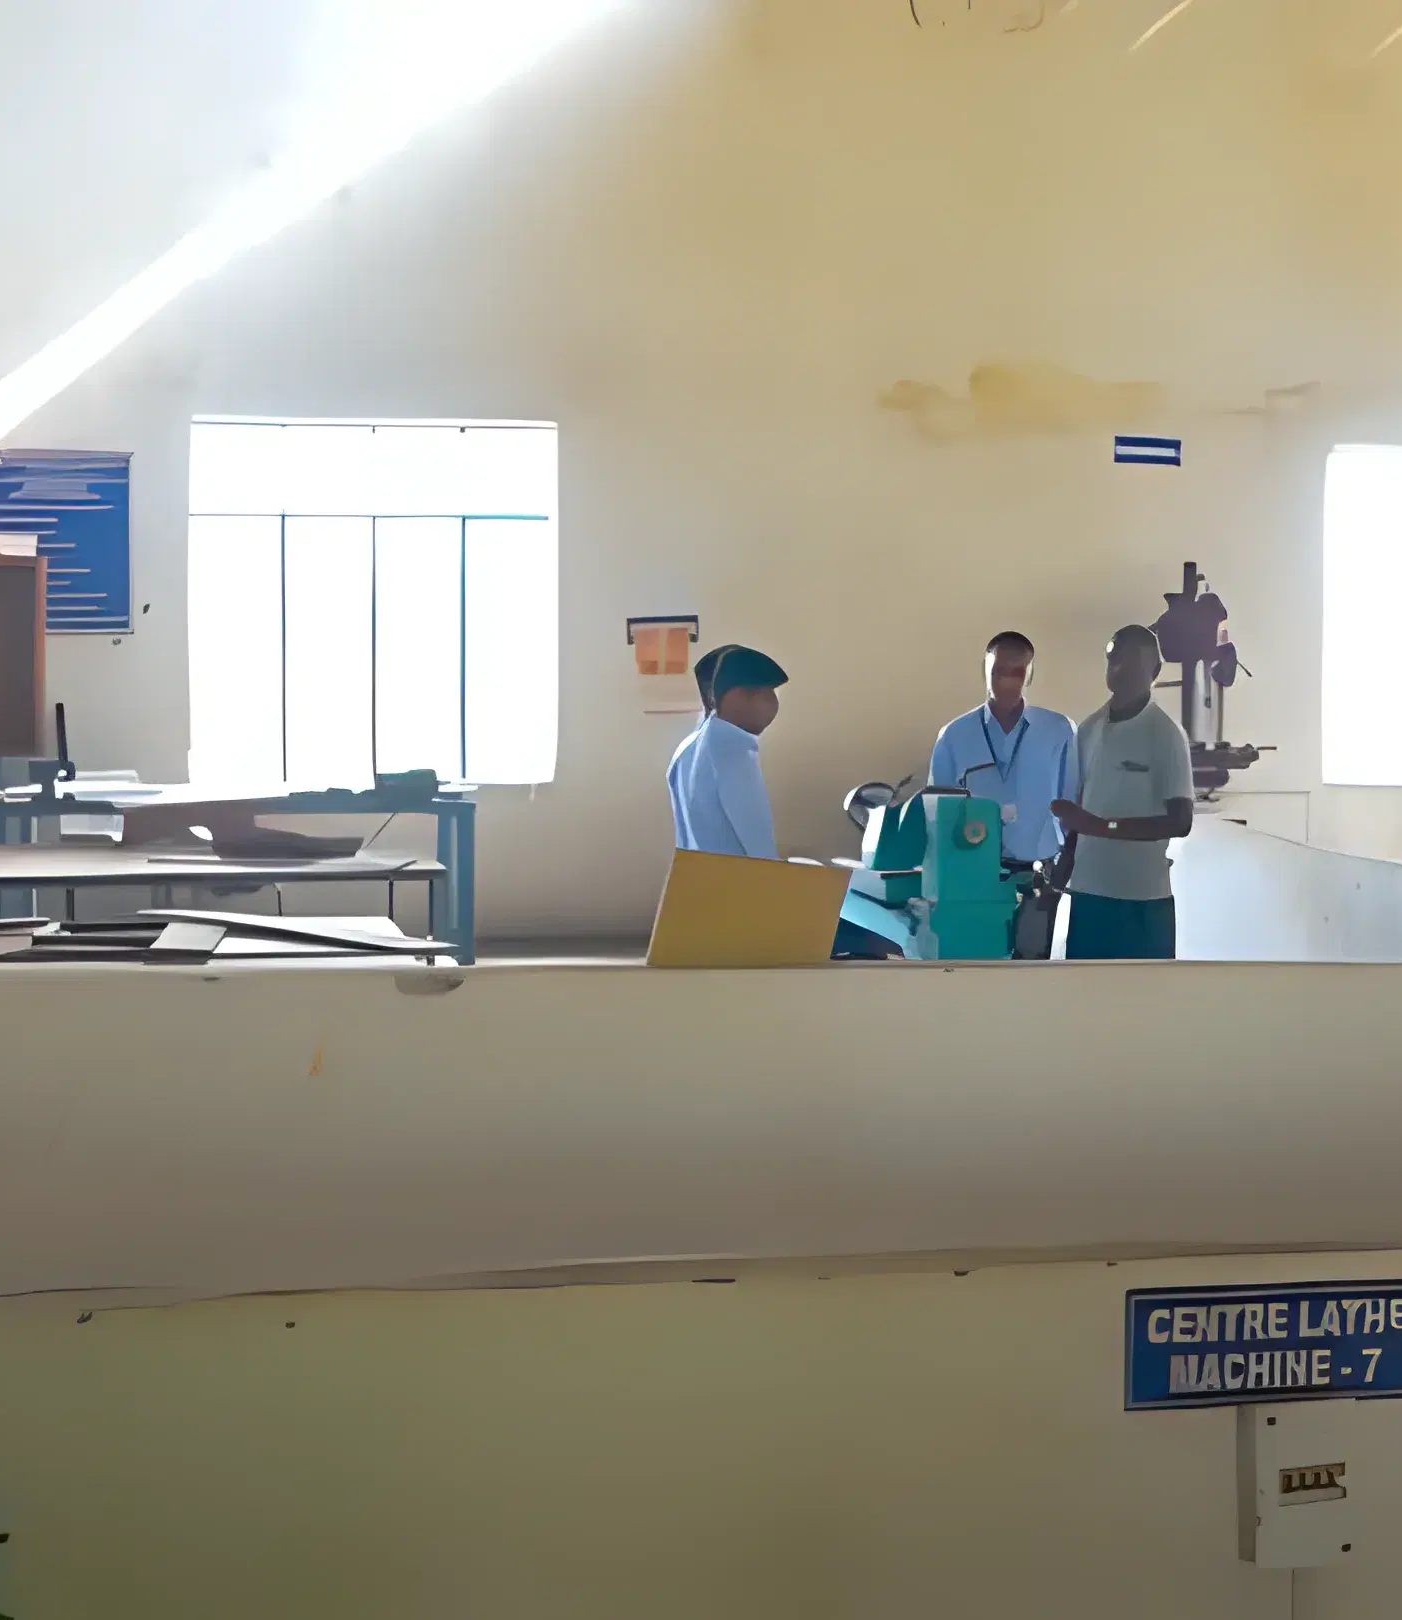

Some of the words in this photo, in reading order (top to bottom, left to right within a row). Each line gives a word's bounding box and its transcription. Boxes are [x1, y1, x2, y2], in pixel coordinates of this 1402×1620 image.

[1148, 1303, 1289, 1343] CENTRE
[1169, 1350, 1331, 1394] MACHINE
[1362, 1348, 1383, 1383] 7
